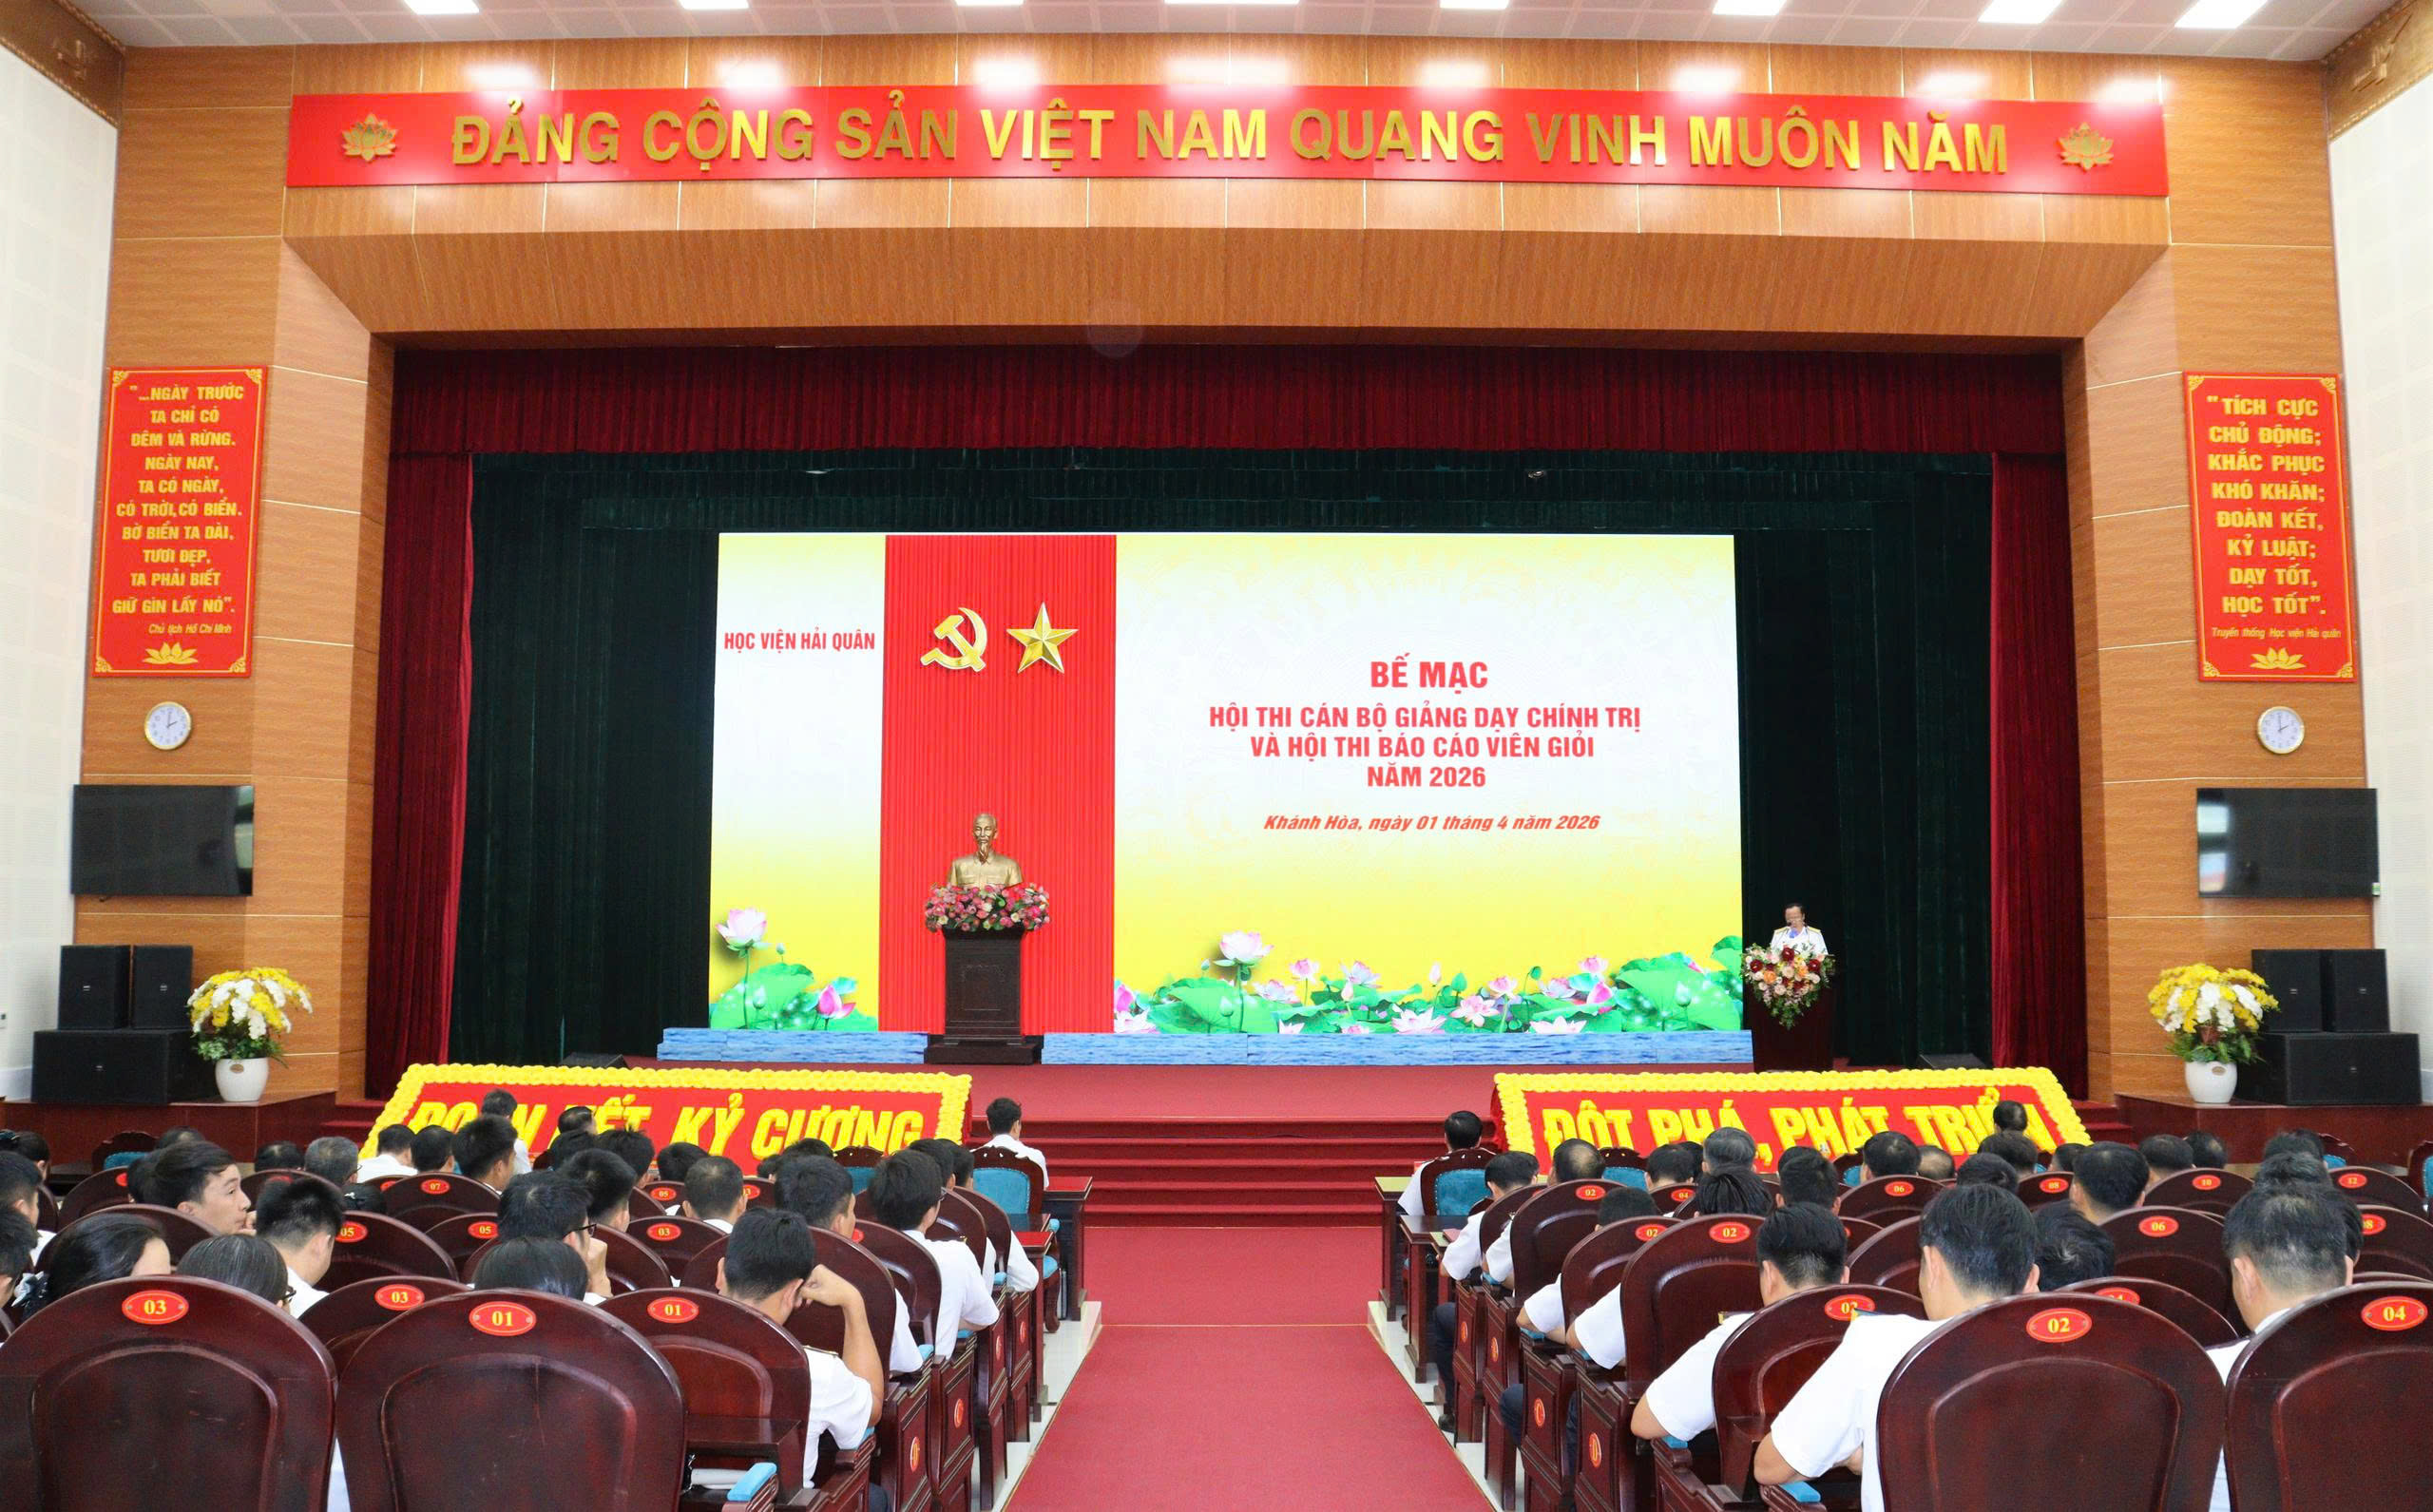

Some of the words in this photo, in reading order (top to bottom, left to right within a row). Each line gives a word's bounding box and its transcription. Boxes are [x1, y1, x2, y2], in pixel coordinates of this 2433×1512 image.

[451, 96, 619, 164] ĐẢNG
[642, 98, 814, 171] CỘNG
[835, 89, 957, 160] SẢN
[980, 98, 1115, 171] VIỆT
[1137, 109, 1267, 160] NAM
[1290, 108, 1504, 162] QUANG
[1527, 113, 1666, 166] VINH
[1689, 105, 1860, 170] MUÔN
[1882, 109, 2007, 174] NĂM
[198, 382, 244, 399] TRƯỚC
[150, 410, 166, 423] TA
[171, 405, 196, 423] CHỈ
[200, 406, 220, 423] CÓ
[2277, 398, 2319, 420] CỰC
[167, 430, 185, 447] VÀ
[2209, 421, 2250, 444] CHỦ
[144, 453, 182, 469] NGÀY
[2208, 448, 2263, 470] KHẮC
[2271, 455, 2325, 476] PHỤC
[138, 479, 155, 493] TA
[158, 476, 178, 493] CÓ
[2212, 479, 2253, 499] KHÓ
[116, 499, 136, 517] CÓ
[179, 498, 198, 516] CÓ
[2216, 507, 2273, 527] ĐOÀN
[122, 522, 143, 540] BỜ
[183, 526, 201, 540] TA
[2227, 533, 2254, 556] KỶ
[143, 548, 175, 563] TƯƠI
[130, 572, 146, 586] TA
[151, 567, 185, 586] PHẢI
[190, 568, 220, 586] BIẾT
[2229, 567, 2267, 588] DẠY
[112, 597, 139, 614] GIỮ
[143, 597, 166, 614] GÌN
[172, 595, 197, 613] LẤY
[2222, 596, 2263, 618] HỌC
[724, 632, 756, 653] HỌC
[760, 629, 796, 653] VIỆN
[800, 625, 827, 649] HẢI
[832, 629, 875, 652] QUÂN
[1370, 652, 1411, 688] BẾ
[1419, 661, 1488, 695] MẠC
[1210, 701, 1248, 732] HỘI
[1255, 707, 1292, 727] THI
[1300, 702, 1349, 728] CÁN
[1356, 702, 1387, 733] BỘ
[1395, 699, 1467, 728] GIẢNG
[1474, 707, 1519, 733] DẠY
[1526, 702, 1599, 728] CHÍNH
[1604, 707, 1640, 733] TRỊ
[1250, 732, 1280, 757] VÀ
[1288, 732, 1327, 762] HỘI
[1333, 737, 1370, 757] THI
[1379, 732, 1425, 757] BÁO
[1433, 732, 1480, 757] CÁO
[1486, 732, 1540, 757] VIÊN
[1547, 729, 1594, 757] GIỎI
[1368, 762, 1422, 787] NĂM
[1429, 766, 1485, 788] 2026
[1263, 814, 1322, 830] Khánh
[1324, 814, 1363, 831] Hòa,
[1369, 814, 1413, 832] ngày
[1416, 815, 1438, 830] 01
[1443, 814, 1494, 832] tháng
[1497, 815, 1508, 830] 4
[1512, 814, 1553, 830] năm
[1555, 814, 1601, 830] 2026
[407, 1101, 547, 1152] ĐON
[546, 1094, 652, 1149] ẾT
[669, 1093, 745, 1157] KỶ
[751, 1104, 924, 1160] CƯƠNG
[340, 1227, 354, 1236] 05
[479, 1226, 491, 1234] 05
[658, 1228, 670, 1236] 03
[1722, 1226, 1738, 1238] 02
[2151, 1221, 2166, 1232] 06
[144, 1299, 166, 1315] 03
[391, 1292, 409, 1304] 03
[491, 1311, 513, 1327] 01
[664, 1304, 681, 1317] 01
[2383, 1306, 2406, 1321] 04
[2047, 1317, 2070, 1333] 02
